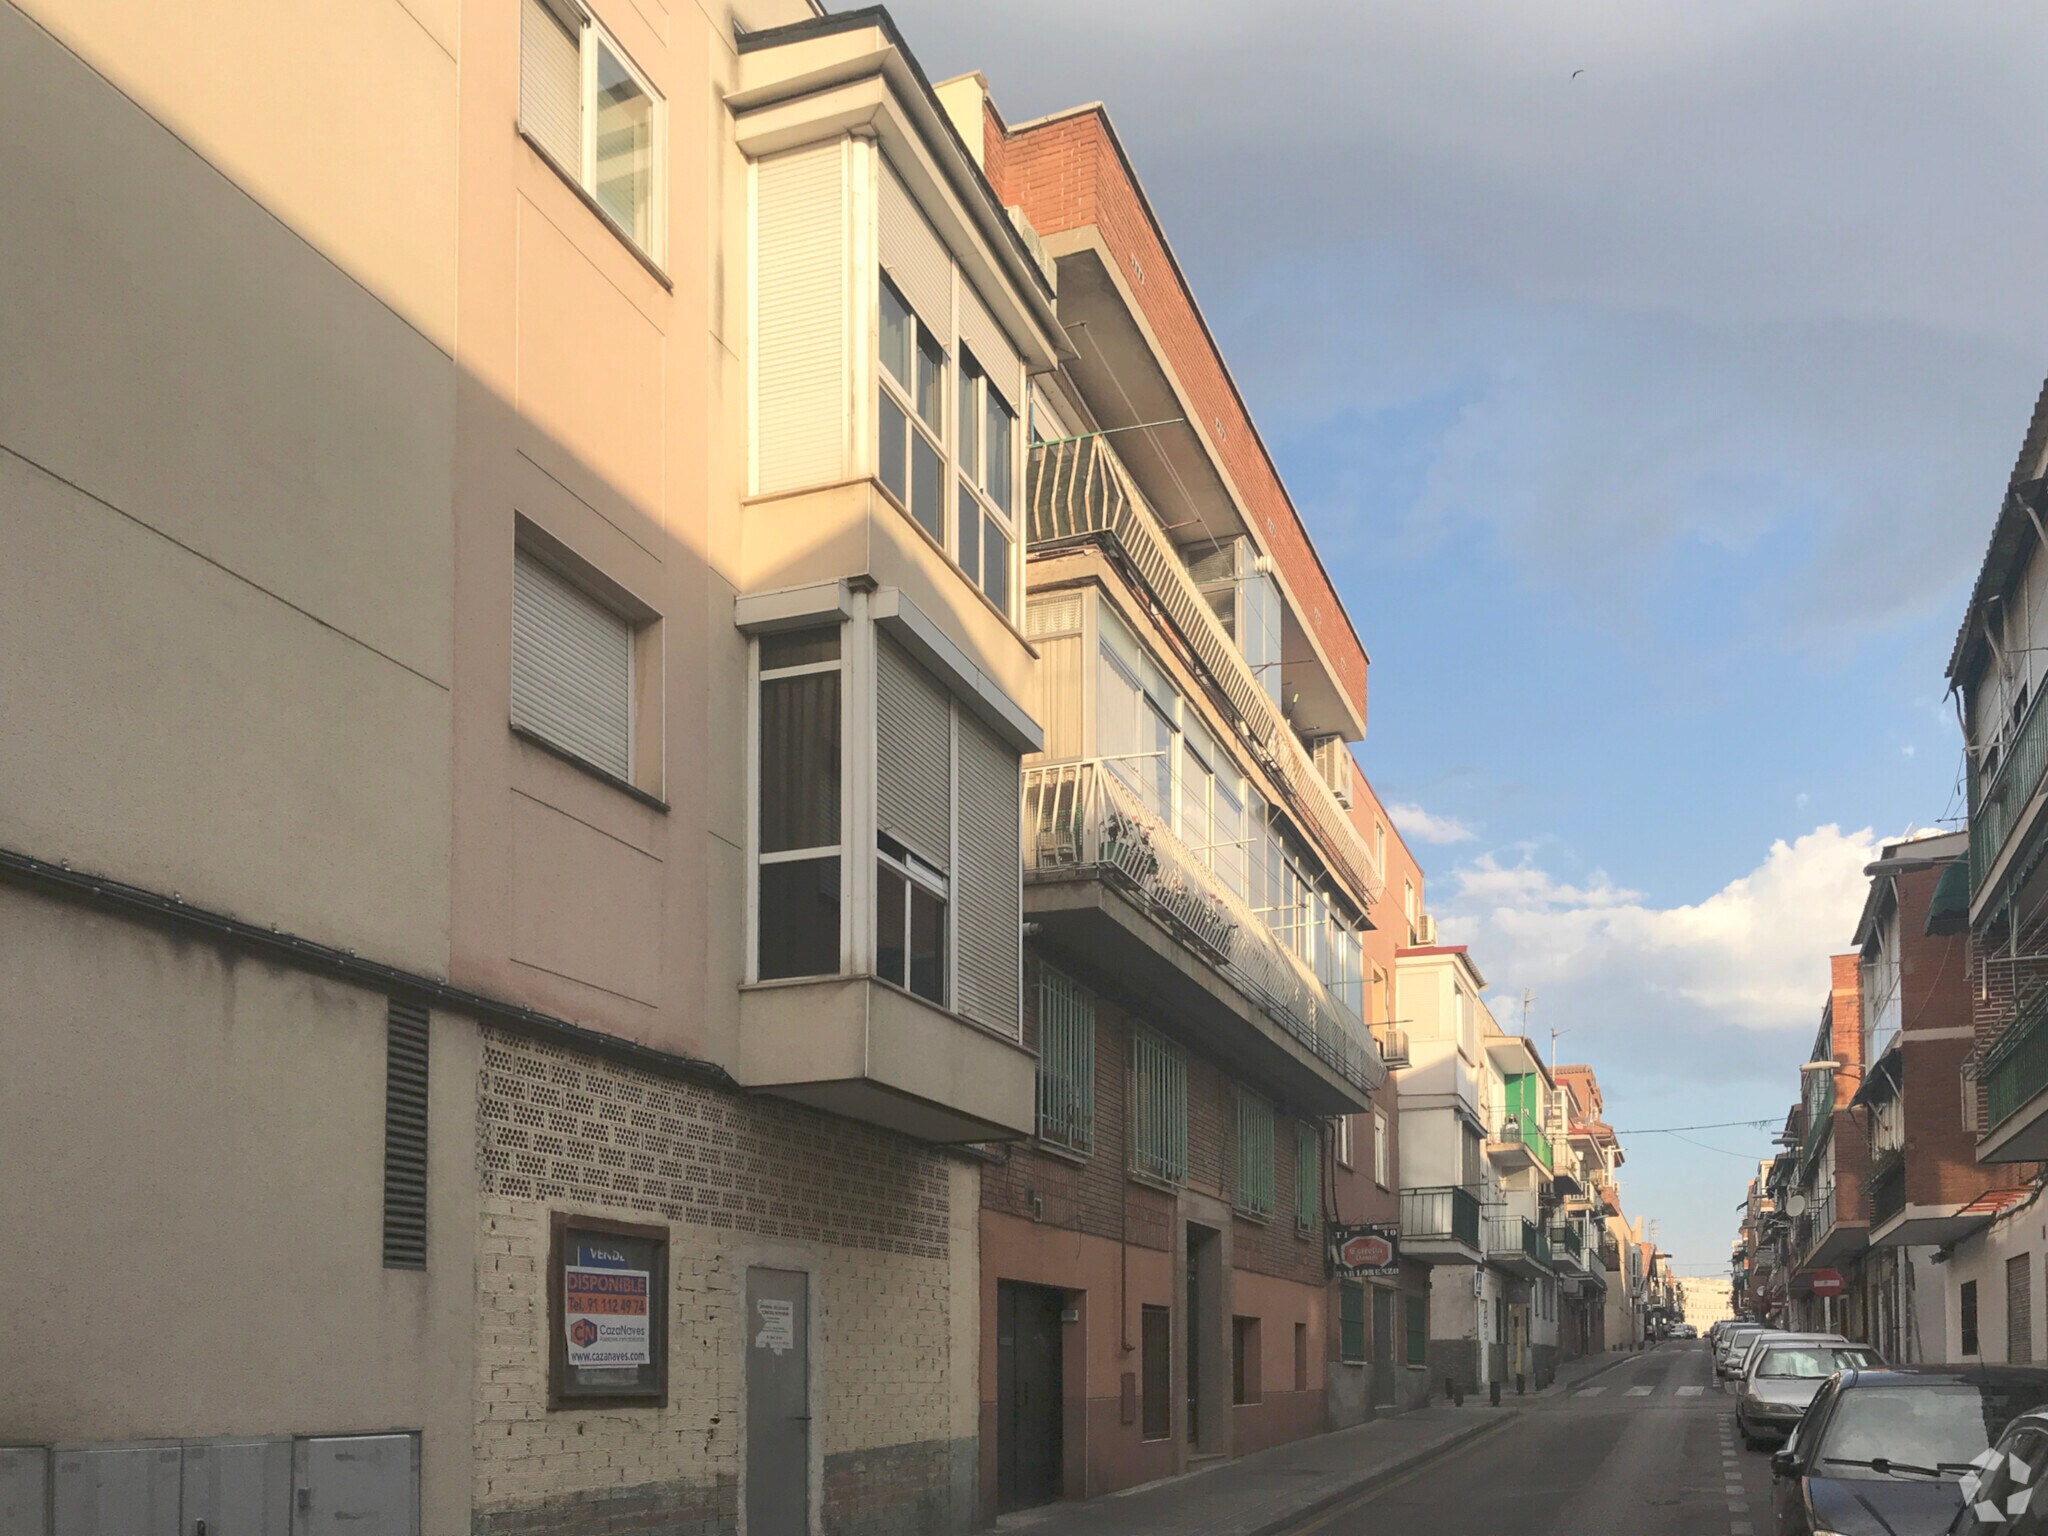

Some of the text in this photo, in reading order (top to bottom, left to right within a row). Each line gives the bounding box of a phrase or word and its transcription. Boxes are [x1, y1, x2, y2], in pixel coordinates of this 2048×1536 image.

[1356, 1267, 1399, 1276] LORENZO
[568, 1273, 646, 1293] DISPONIBLE
[568, 1296, 645, 1314] Tel. 91 112 49 74
[575, 1325, 595, 1341] CN
[599, 1324, 645, 1336] CazaNaves
[571, 1351, 645, 1362] www.cazanaves.com
